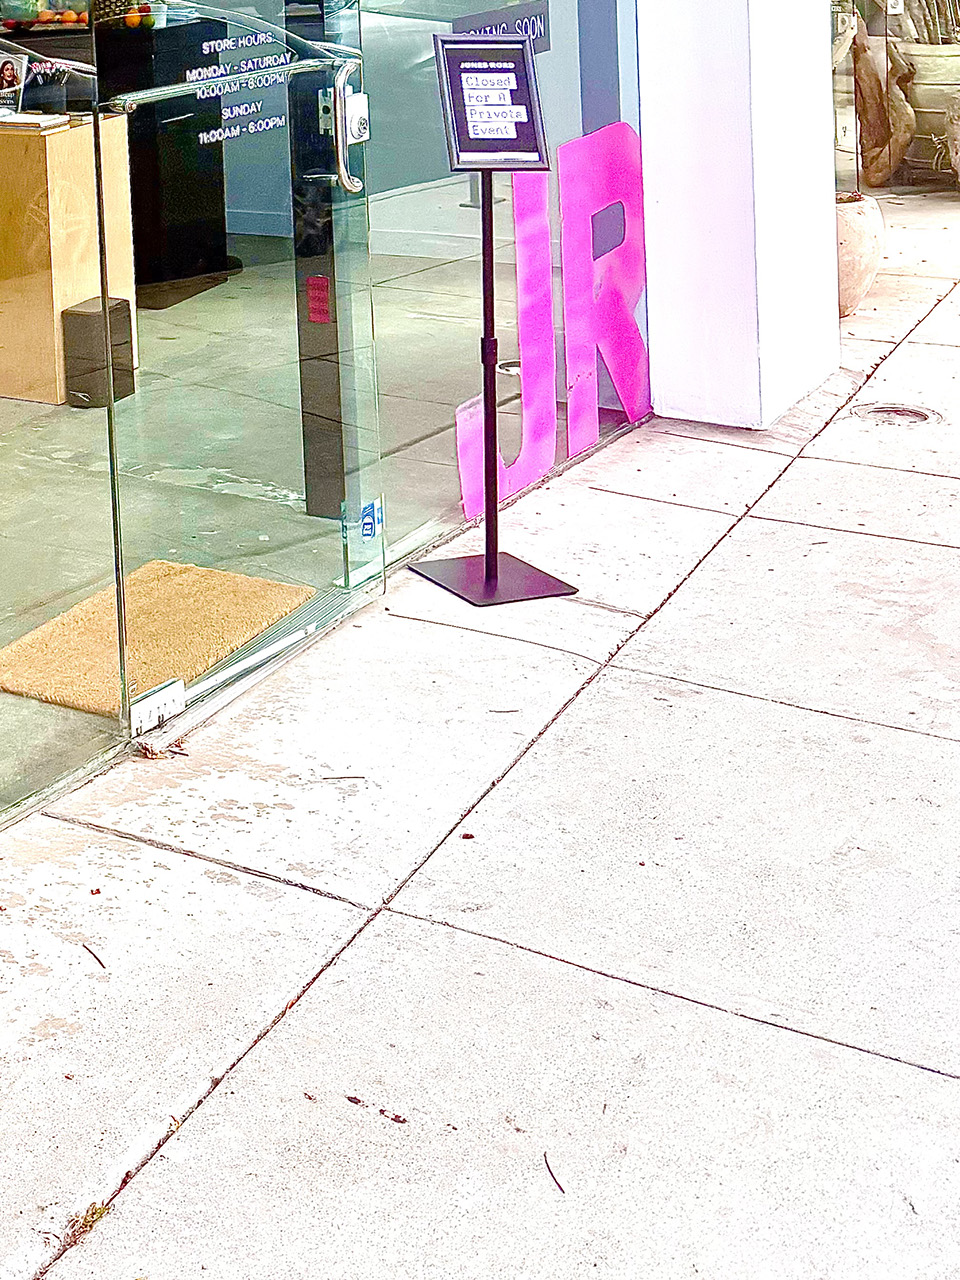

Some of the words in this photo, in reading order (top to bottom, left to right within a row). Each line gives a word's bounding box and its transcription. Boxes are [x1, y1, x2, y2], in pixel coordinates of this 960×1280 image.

[202, 37, 236, 54] STORE
[240, 32, 275, 48] HOURS:
[186, 63, 232, 82] MONDAY
[240, 52, 291, 70] SATURDAY
[466, 76, 511, 87] Closed
[222, 101, 263, 119] SUNDAY
[198, 127, 240, 145] 11:00AM
[472, 125, 510, 136] Event
